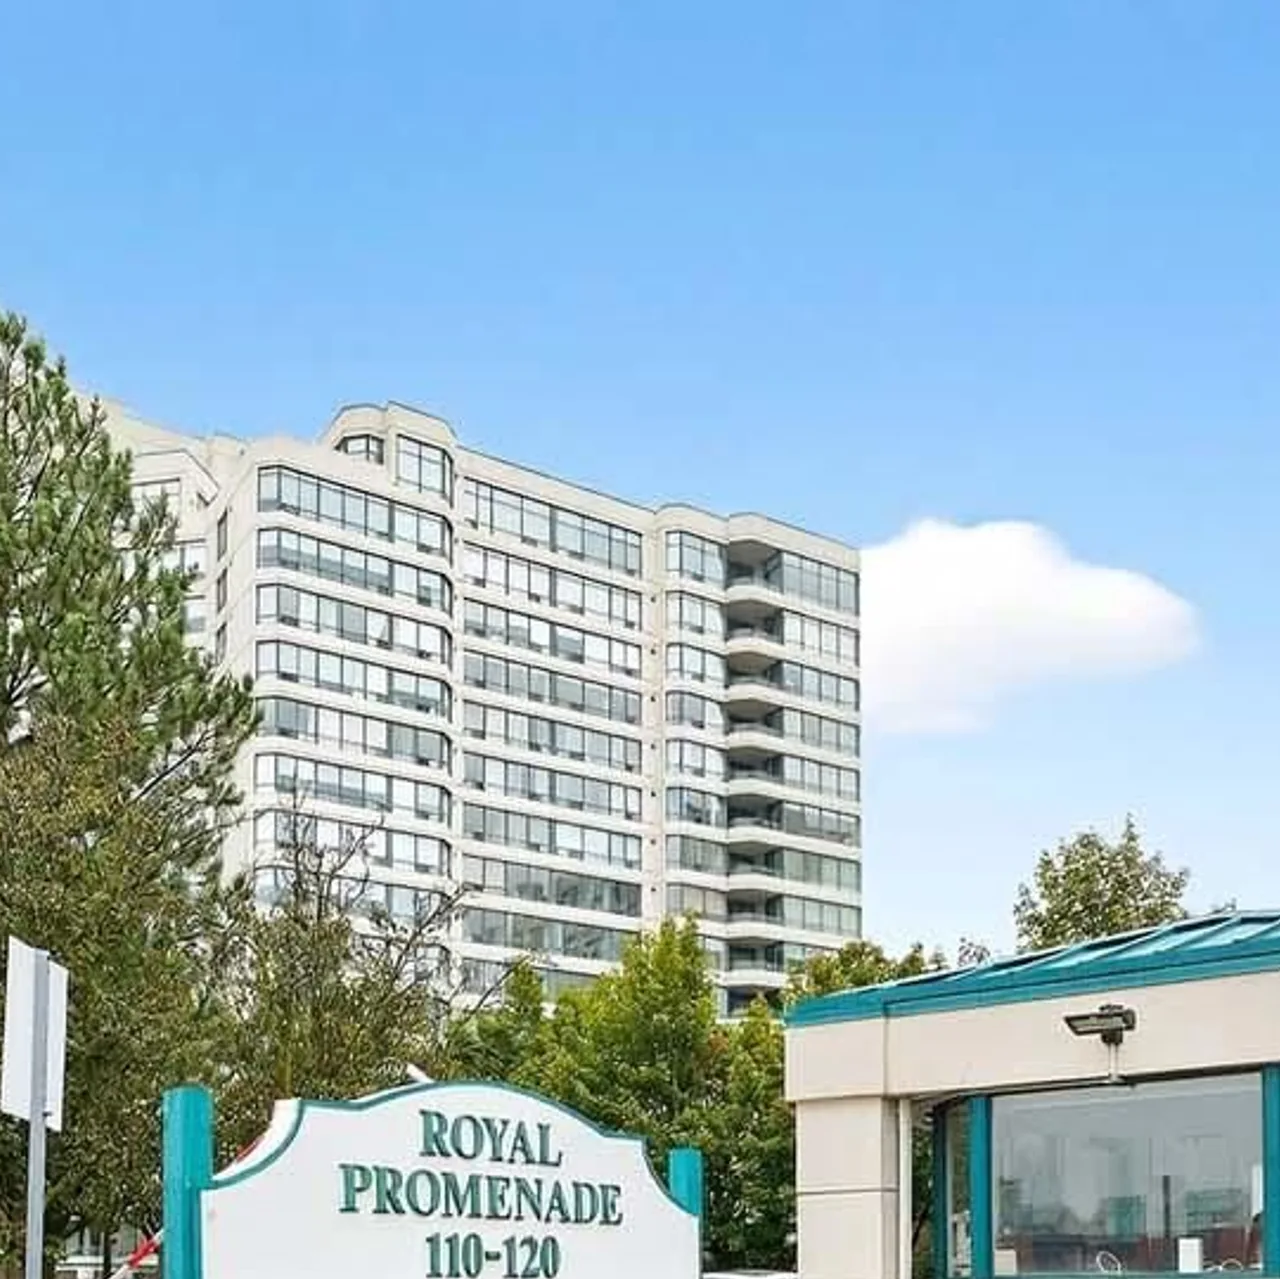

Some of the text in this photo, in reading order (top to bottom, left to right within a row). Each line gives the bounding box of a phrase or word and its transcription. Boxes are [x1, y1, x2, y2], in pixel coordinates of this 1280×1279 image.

[419, 1109, 563, 1167] ROYAL
[338, 1163, 624, 1226] PROMENADE
[425, 1231, 561, 1279] 110-120
